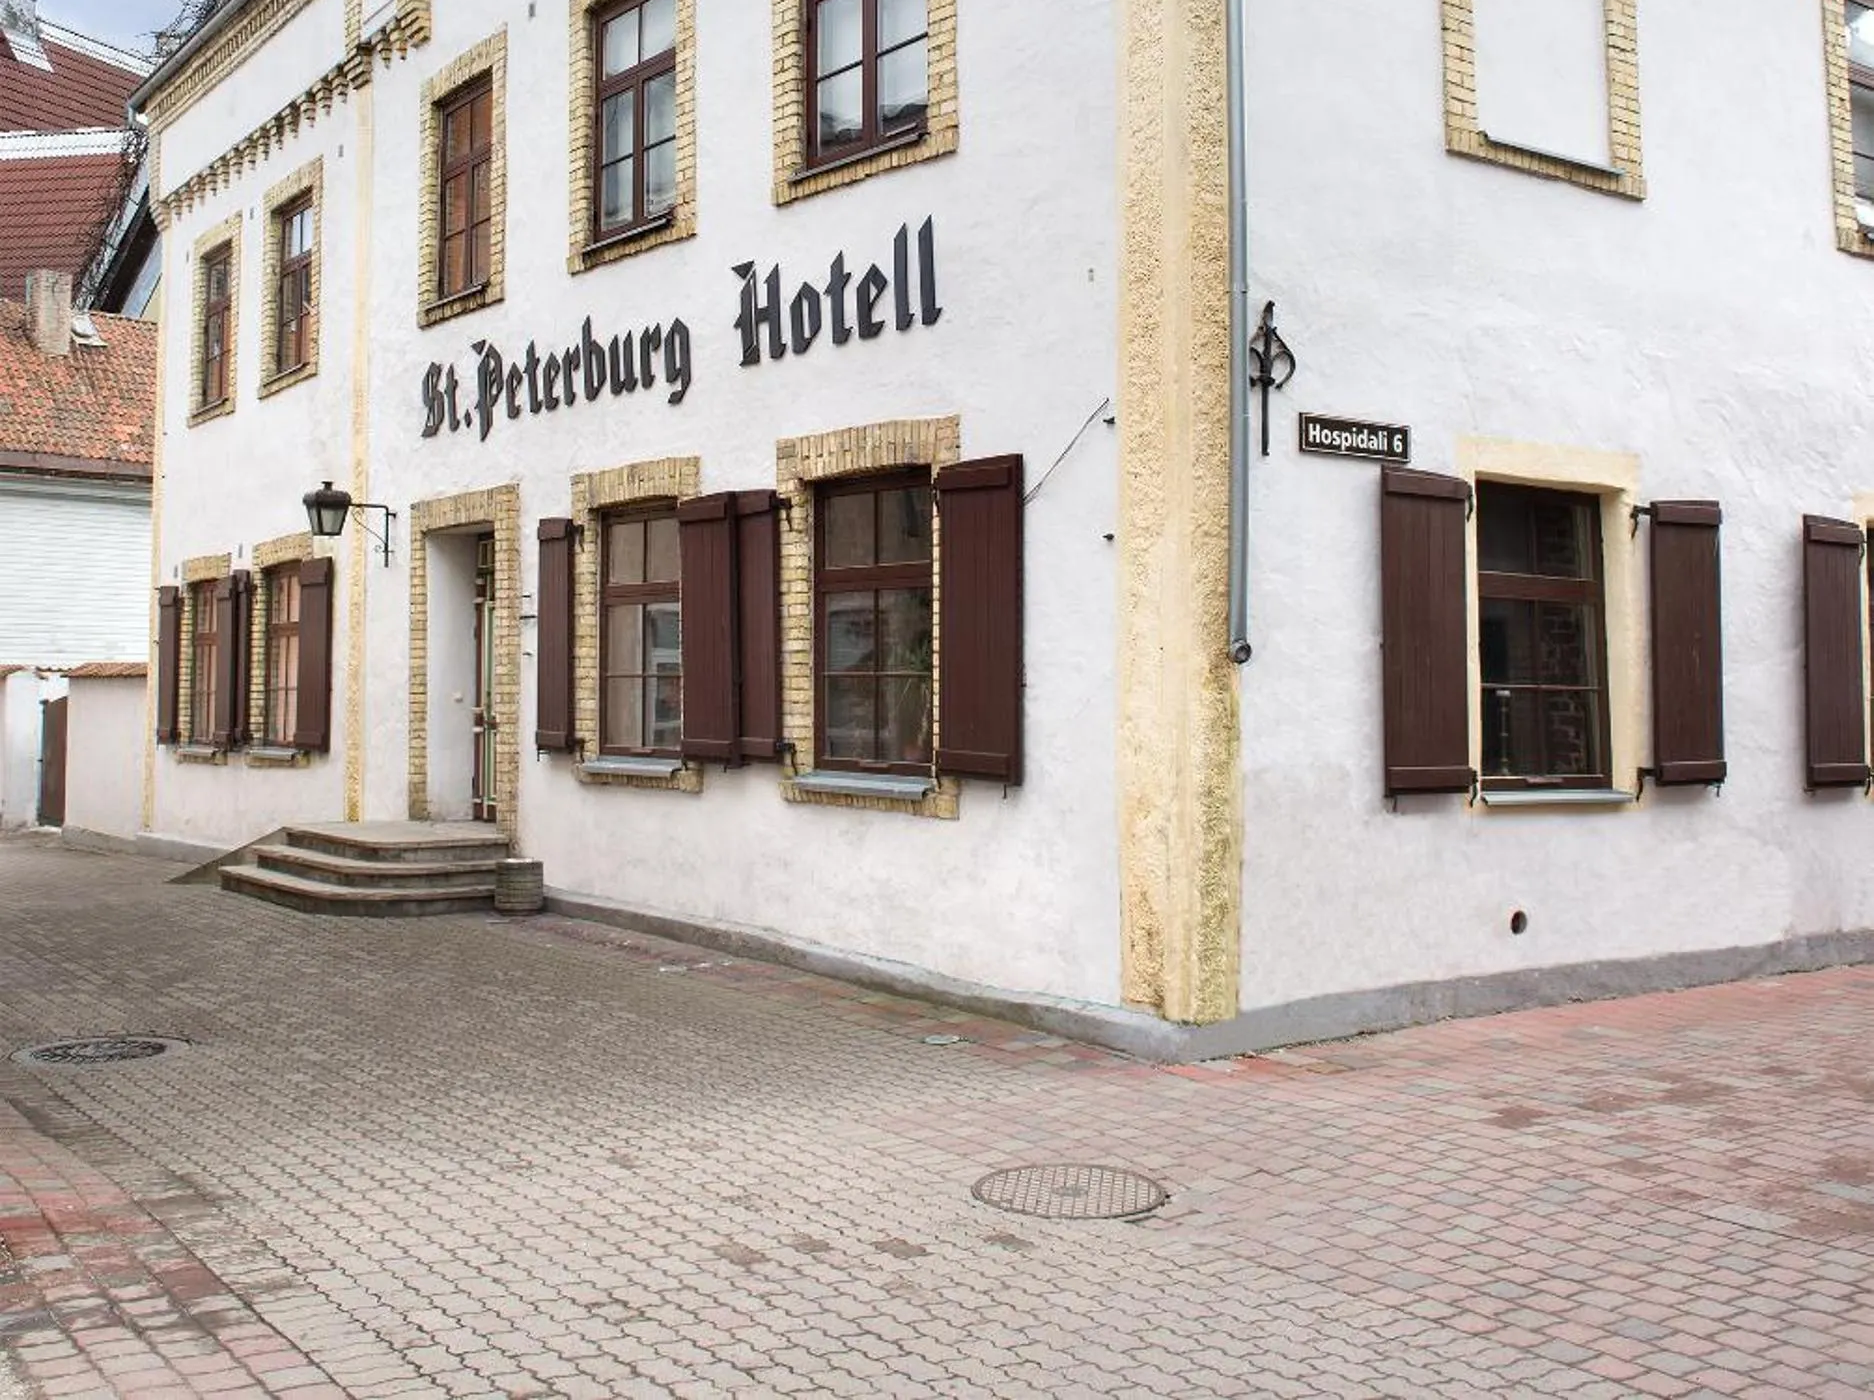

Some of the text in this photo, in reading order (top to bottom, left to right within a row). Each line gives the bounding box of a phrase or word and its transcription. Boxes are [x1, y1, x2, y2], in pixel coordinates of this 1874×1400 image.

[731, 214, 942, 366] Hotell
[1308, 423, 1403, 453] Hospidali 6
